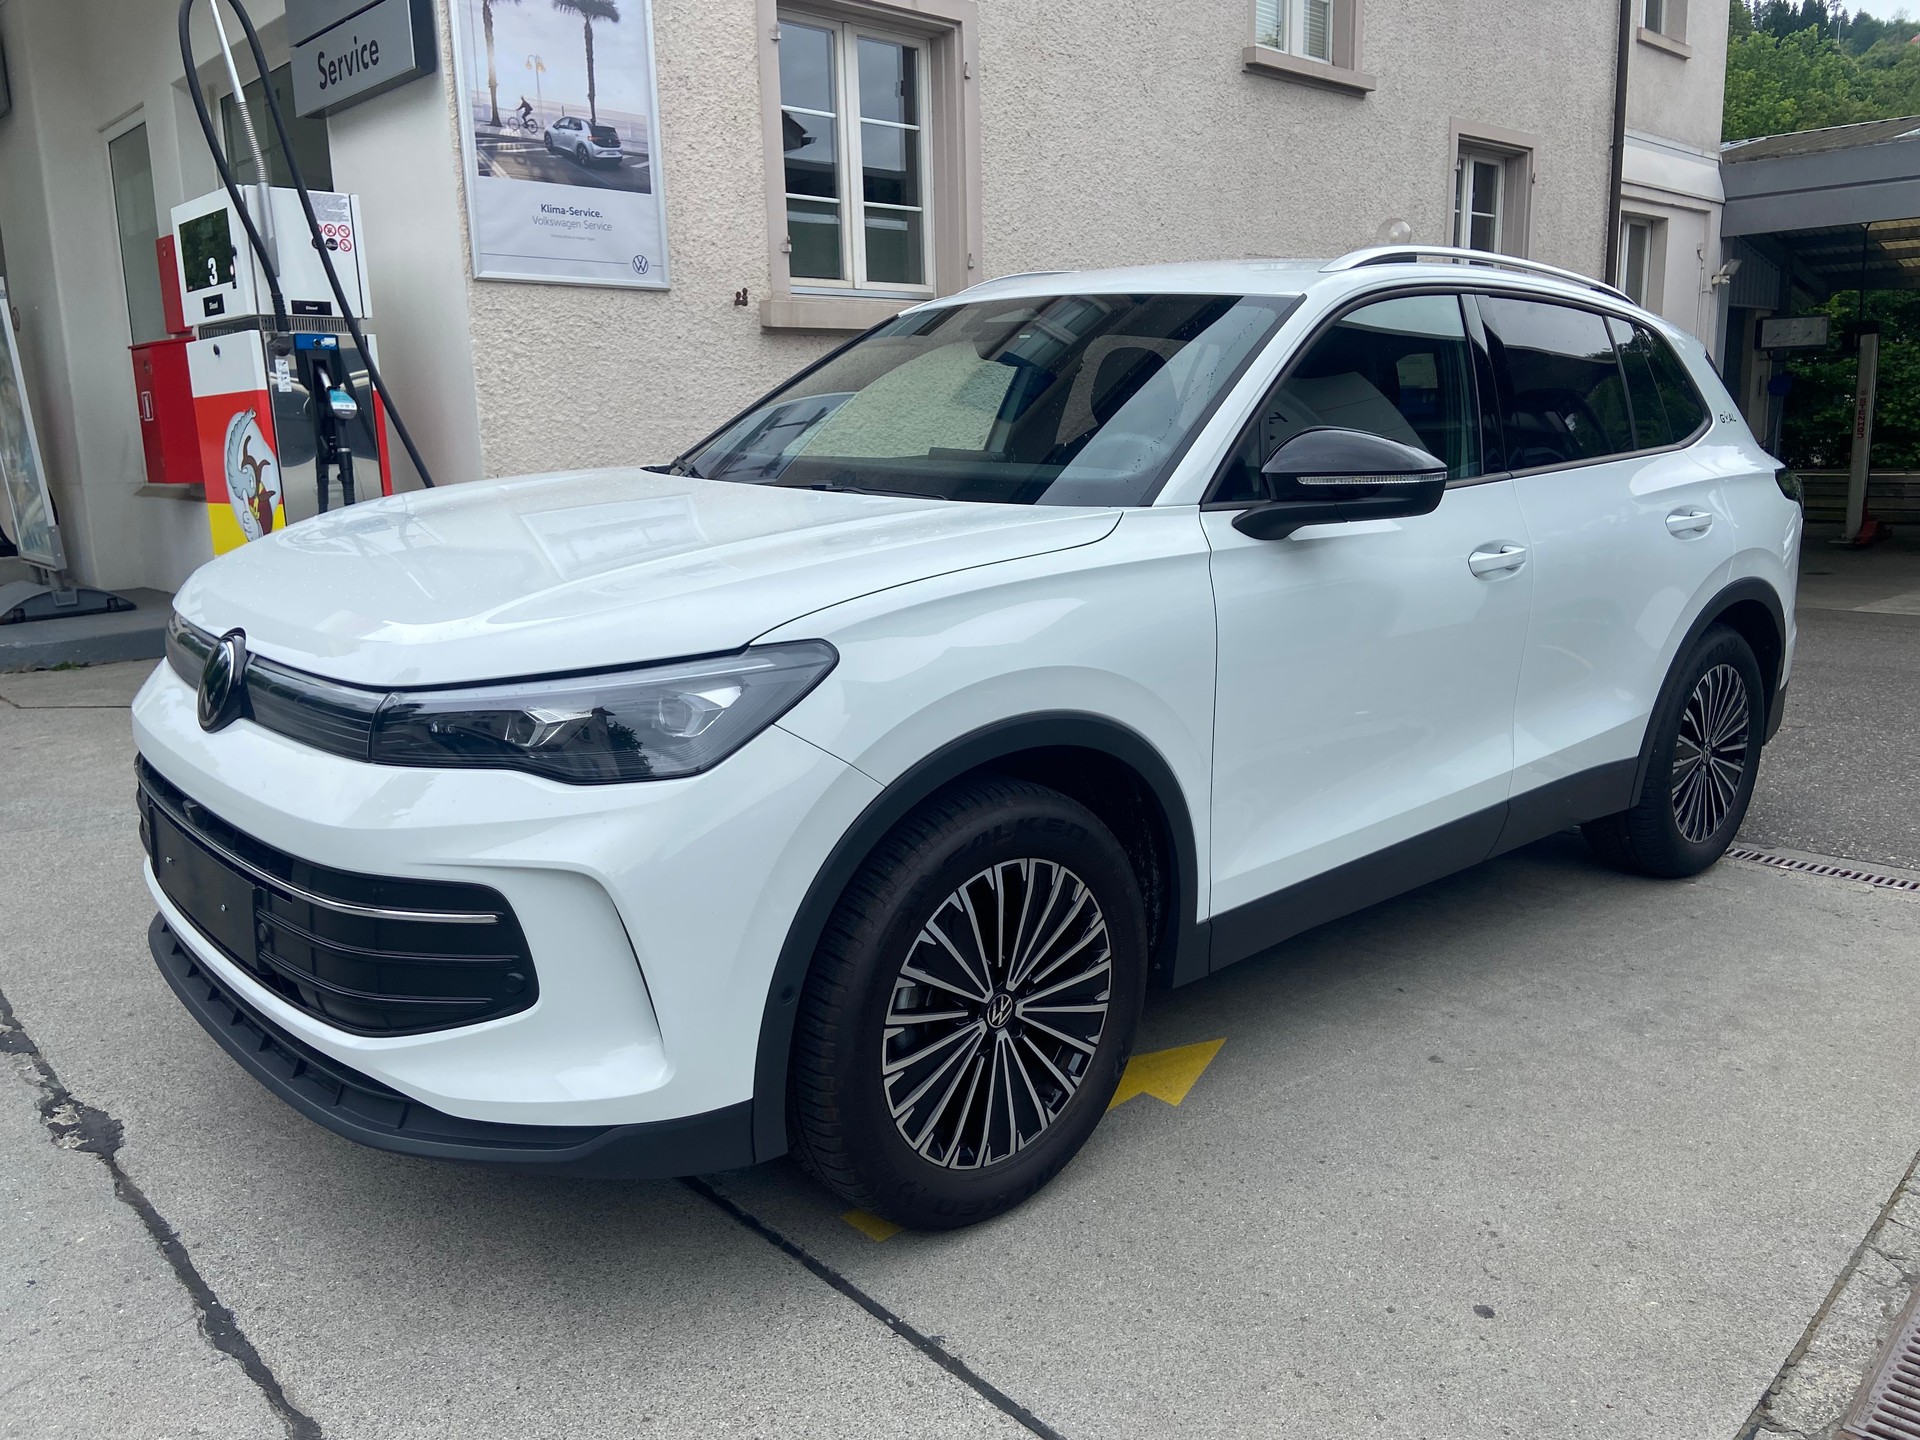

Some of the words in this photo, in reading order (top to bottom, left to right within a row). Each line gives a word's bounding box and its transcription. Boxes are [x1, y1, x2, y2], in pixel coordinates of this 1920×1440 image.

[317, 35, 380, 90] Service
[540, 203, 603, 218] Klima-Service.
[532, 215, 581, 230] Volkswagen
[583, 219, 613, 232] Service
[207, 257, 218, 286] 3
